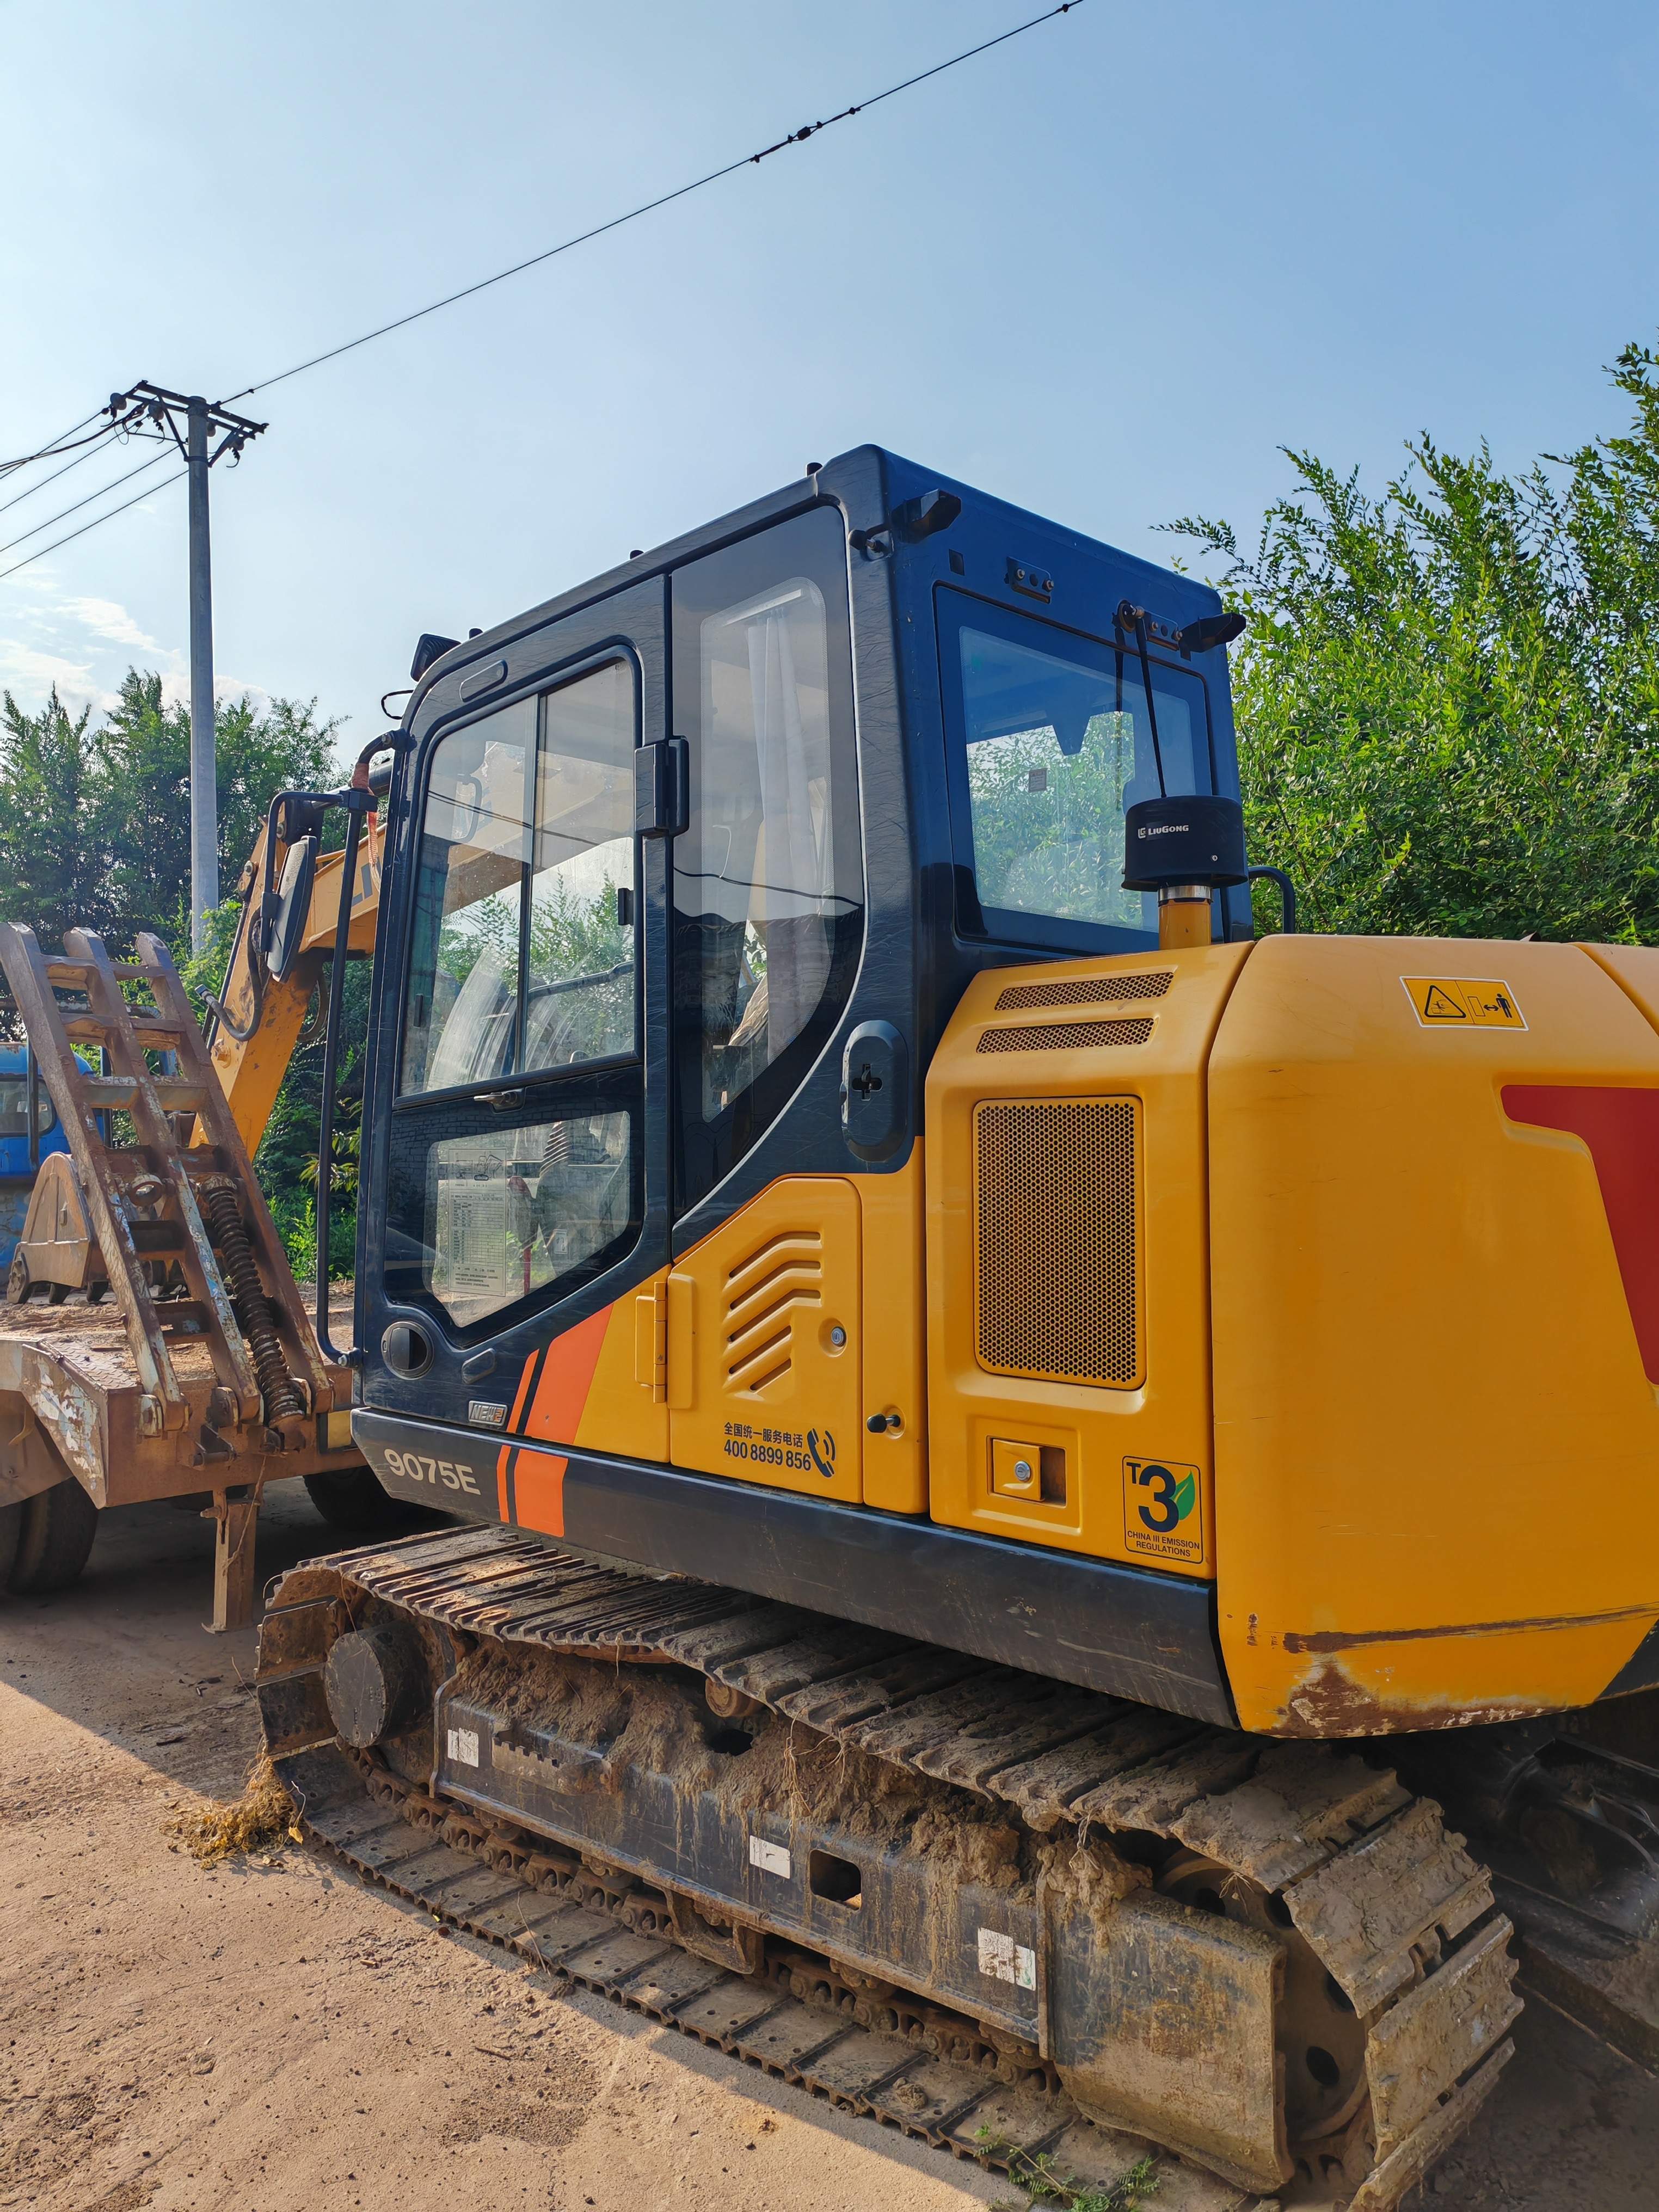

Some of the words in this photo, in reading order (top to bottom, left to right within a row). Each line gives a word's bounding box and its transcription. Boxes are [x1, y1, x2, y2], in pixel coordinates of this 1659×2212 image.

[724, 1422, 803, 1448] 全国统一服务电话
[724, 1439, 748, 1459] 400
[750, 1443, 783, 1465] 8899
[785, 1450, 811, 1471] 856
[384, 1448, 481, 1495] 9075E
[1127, 1531, 1151, 1541] CHINA
[1162, 1537, 1200, 1550] EMISSION
[1136, 1541, 1191, 1557] REGULATIONS
